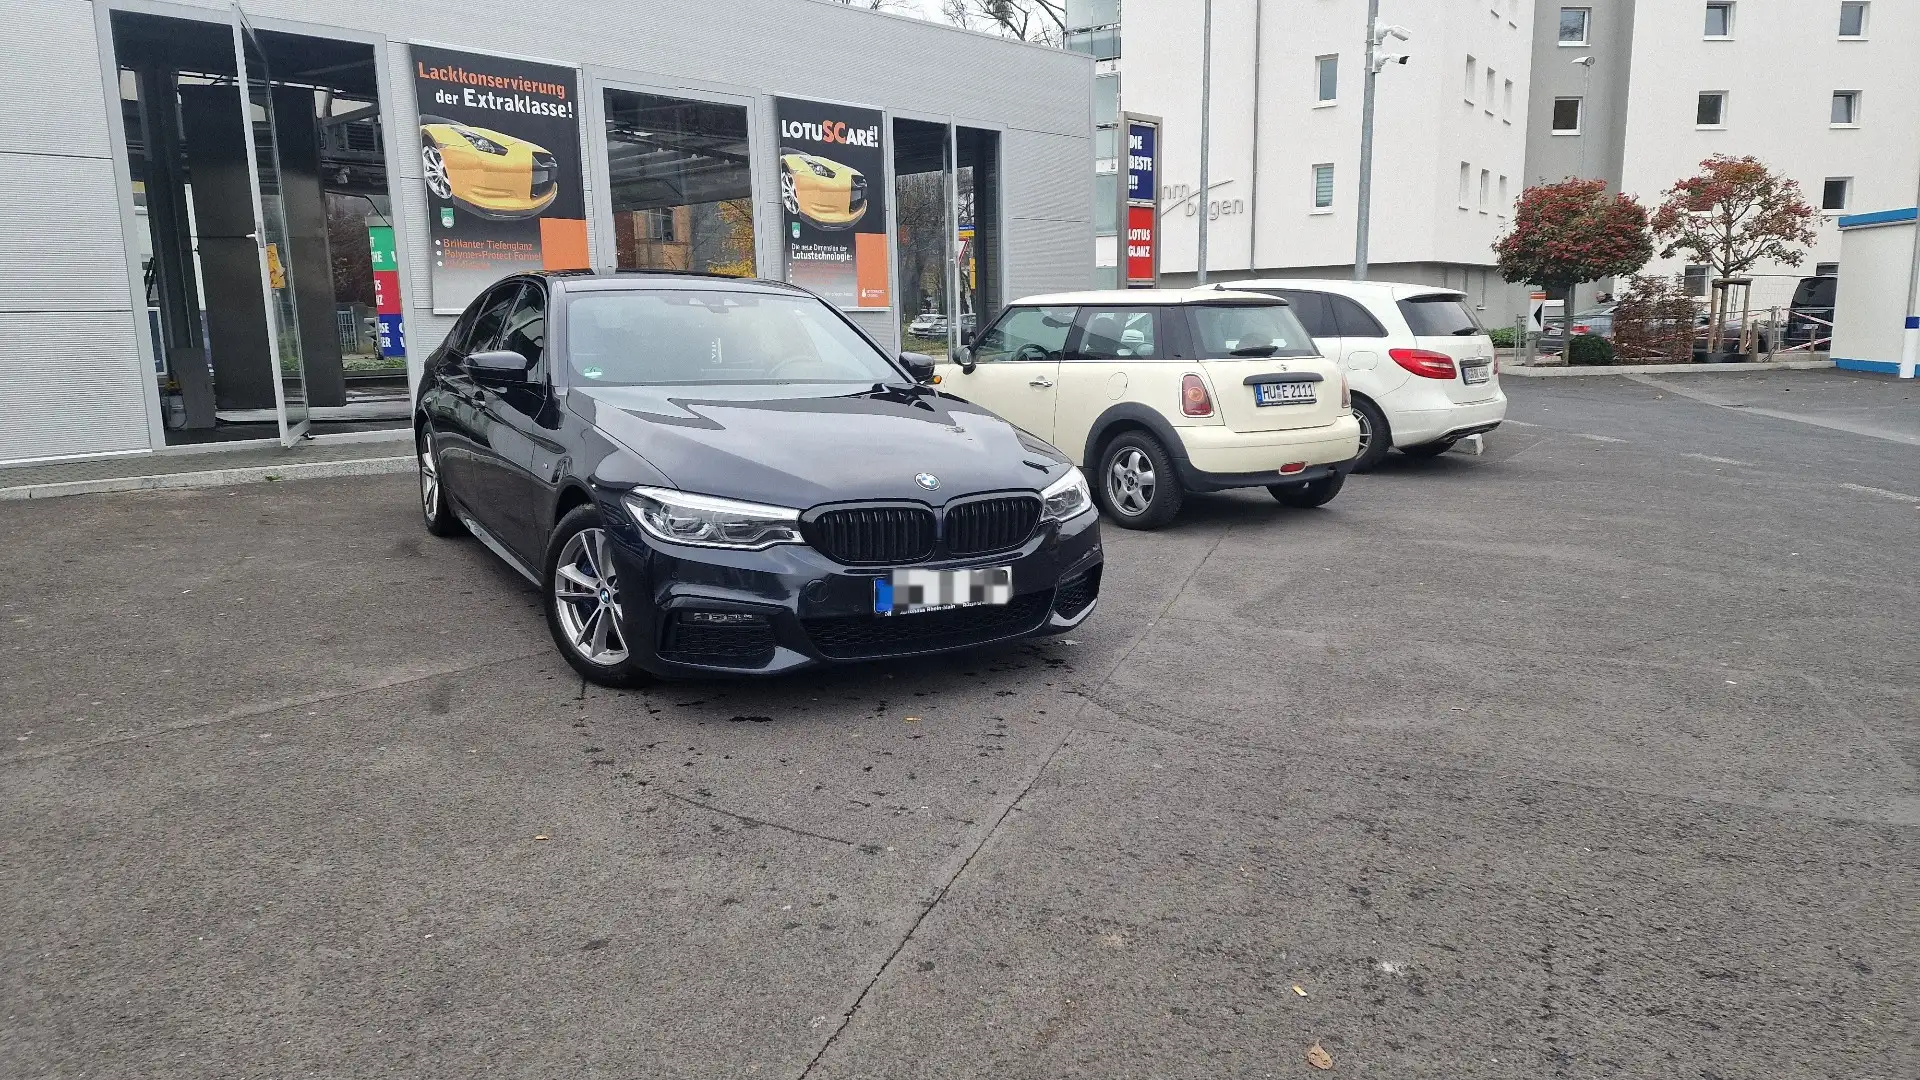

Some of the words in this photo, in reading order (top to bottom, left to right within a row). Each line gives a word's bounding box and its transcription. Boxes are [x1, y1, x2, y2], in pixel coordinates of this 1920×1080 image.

[418, 61, 566, 99] Lackkonservierung
[435, 89, 459, 105] der
[463, 87, 573, 119] Extraklasse!
[1129, 134, 1143, 150] DIE
[1129, 154, 1153, 171] BESTE
[1129, 175, 1139, 190] !!!
[1128, 228, 1151, 241] LOTUS
[443, 238, 485, 249] Brillanter
[487, 240, 533, 251] Tiefenglanz
[1128, 245, 1151, 258] GLANZ
[444, 249, 512, 261] Polymer-Protect
[792, 250, 853, 262] Lotustechnologie:
[1263, 385, 1276, 399] HU
[1281, 385, 1289, 398] E
[1290, 384, 1314, 398] 2111
